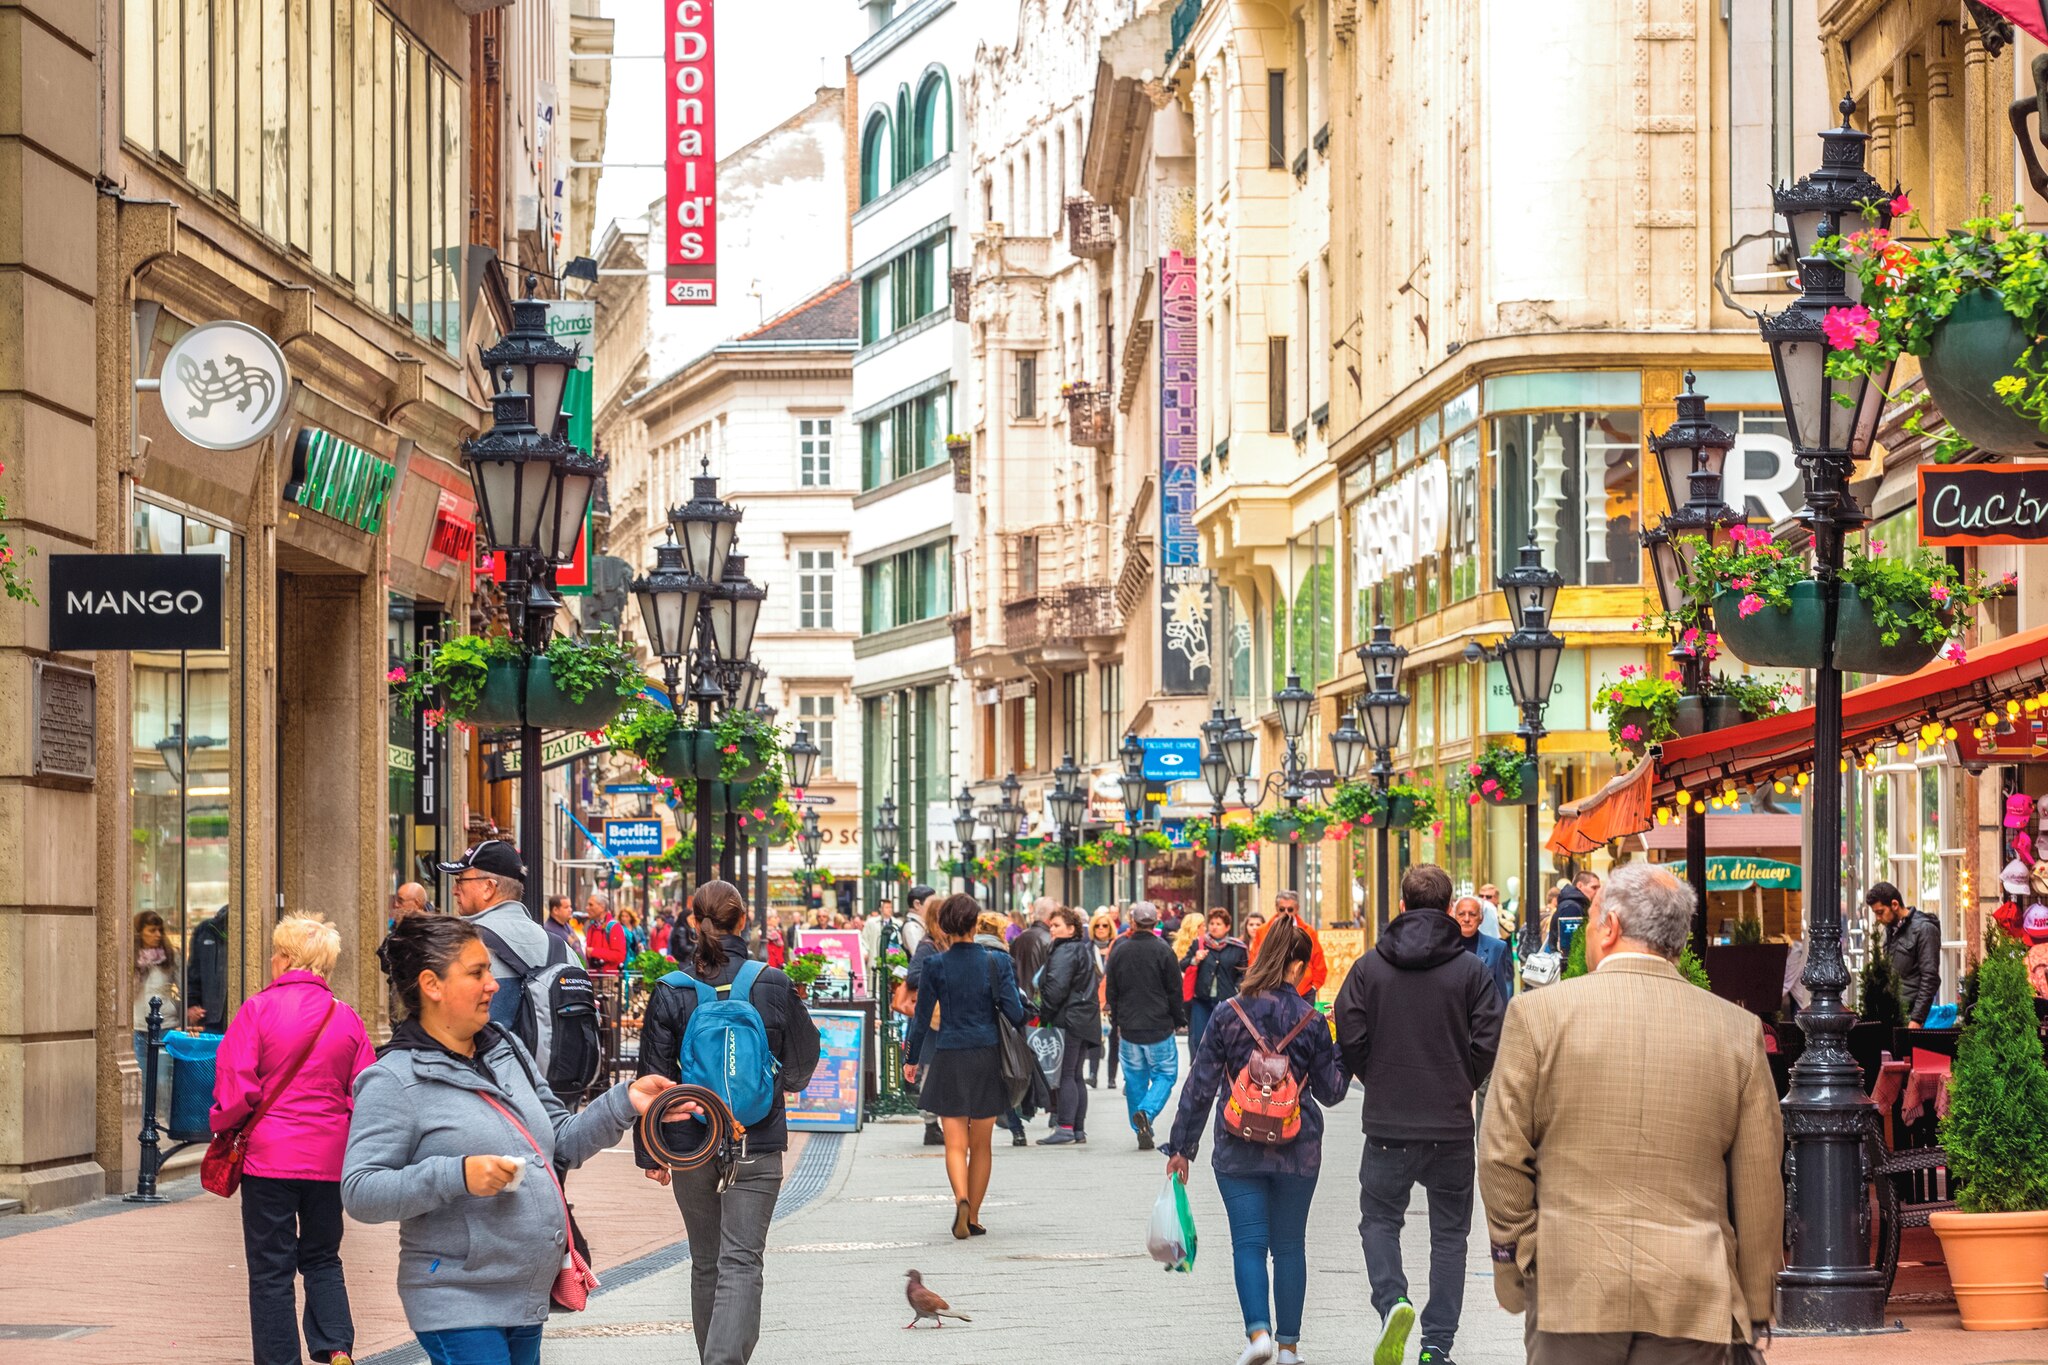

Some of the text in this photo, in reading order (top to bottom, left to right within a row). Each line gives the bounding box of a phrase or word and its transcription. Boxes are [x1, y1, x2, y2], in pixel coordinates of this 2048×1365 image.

[66, 590, 204, 615] MANGO
[609, 823, 658, 837] Berlitz
[609, 837, 658, 847] Nyelviskola
[1731, 863, 1791, 882] delicacys
